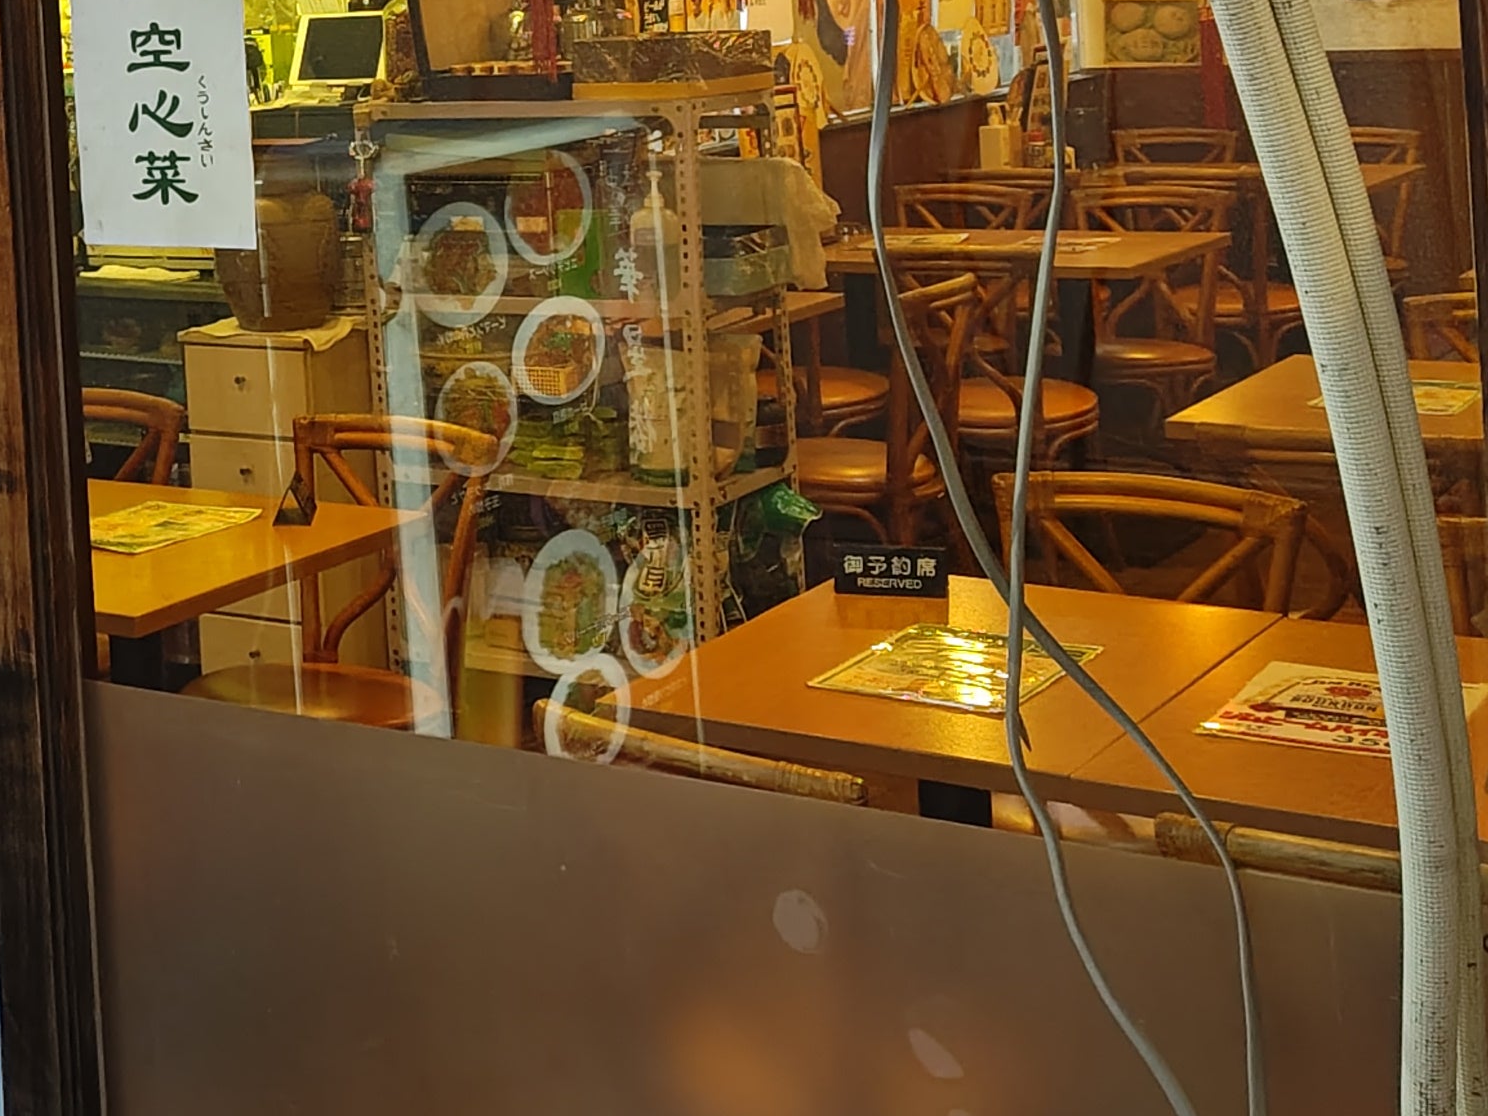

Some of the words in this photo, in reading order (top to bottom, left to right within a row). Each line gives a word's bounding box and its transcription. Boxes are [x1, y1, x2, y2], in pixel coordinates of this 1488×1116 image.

[127, 22, 200, 205] 空心菜
[197, 75, 214, 167] くうしんさい
[843, 554, 937, 578] 御予約席
[856, 576, 923, 591] RESERVED
